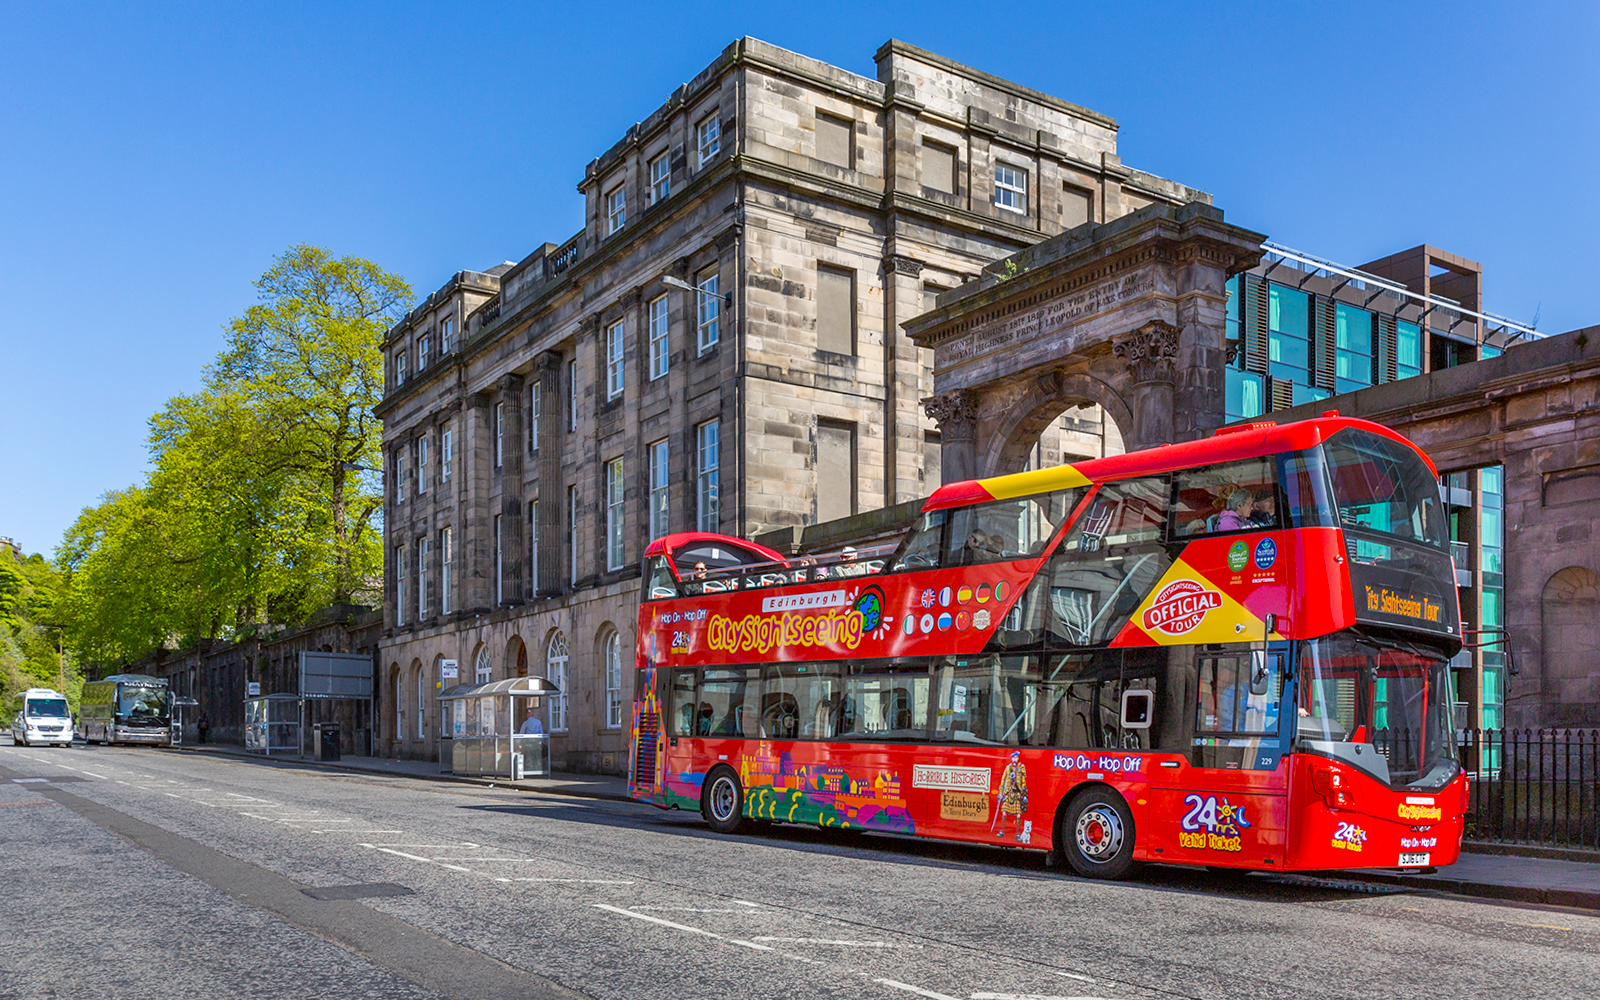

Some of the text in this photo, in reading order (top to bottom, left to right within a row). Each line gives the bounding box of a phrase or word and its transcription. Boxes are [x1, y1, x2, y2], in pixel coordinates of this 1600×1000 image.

[1048, 302, 1065, 315] FOR
[976, 332, 1013, 354] HIGHNESS
[1045, 308, 1082, 327] LEOPOLD
[769, 593, 838, 608] Edinburgh
[1150, 593, 1217, 625] OFFICIAL
[1381, 588, 1421, 618] Sightseeing
[1423, 597, 1439, 621] Tour
[660, 612, 672, 625] Hop
[672, 611, 681, 623] On
[684, 610, 696, 623] Hop
[697, 608, 707, 620] Off
[1170, 614, 1200, 632] TOUR
[672, 630, 683, 648] 24
[1053, 754, 1074, 772] Hop
[1076, 754, 1091, 771] On
[1099, 755, 1121, 773] Hop
[1123, 756, 1142, 773] Off
[1261, 757, 1273, 766] 229
[917, 770, 986, 786] HORRIBLE HISTORIES
[943, 794, 987, 813] Edinburgh
[963, 808, 977, 819] Deary
[1181, 793, 1217, 833] 24
[1334, 821, 1355, 842] 24
[1179, 832, 1242, 852] Valid Ticket
